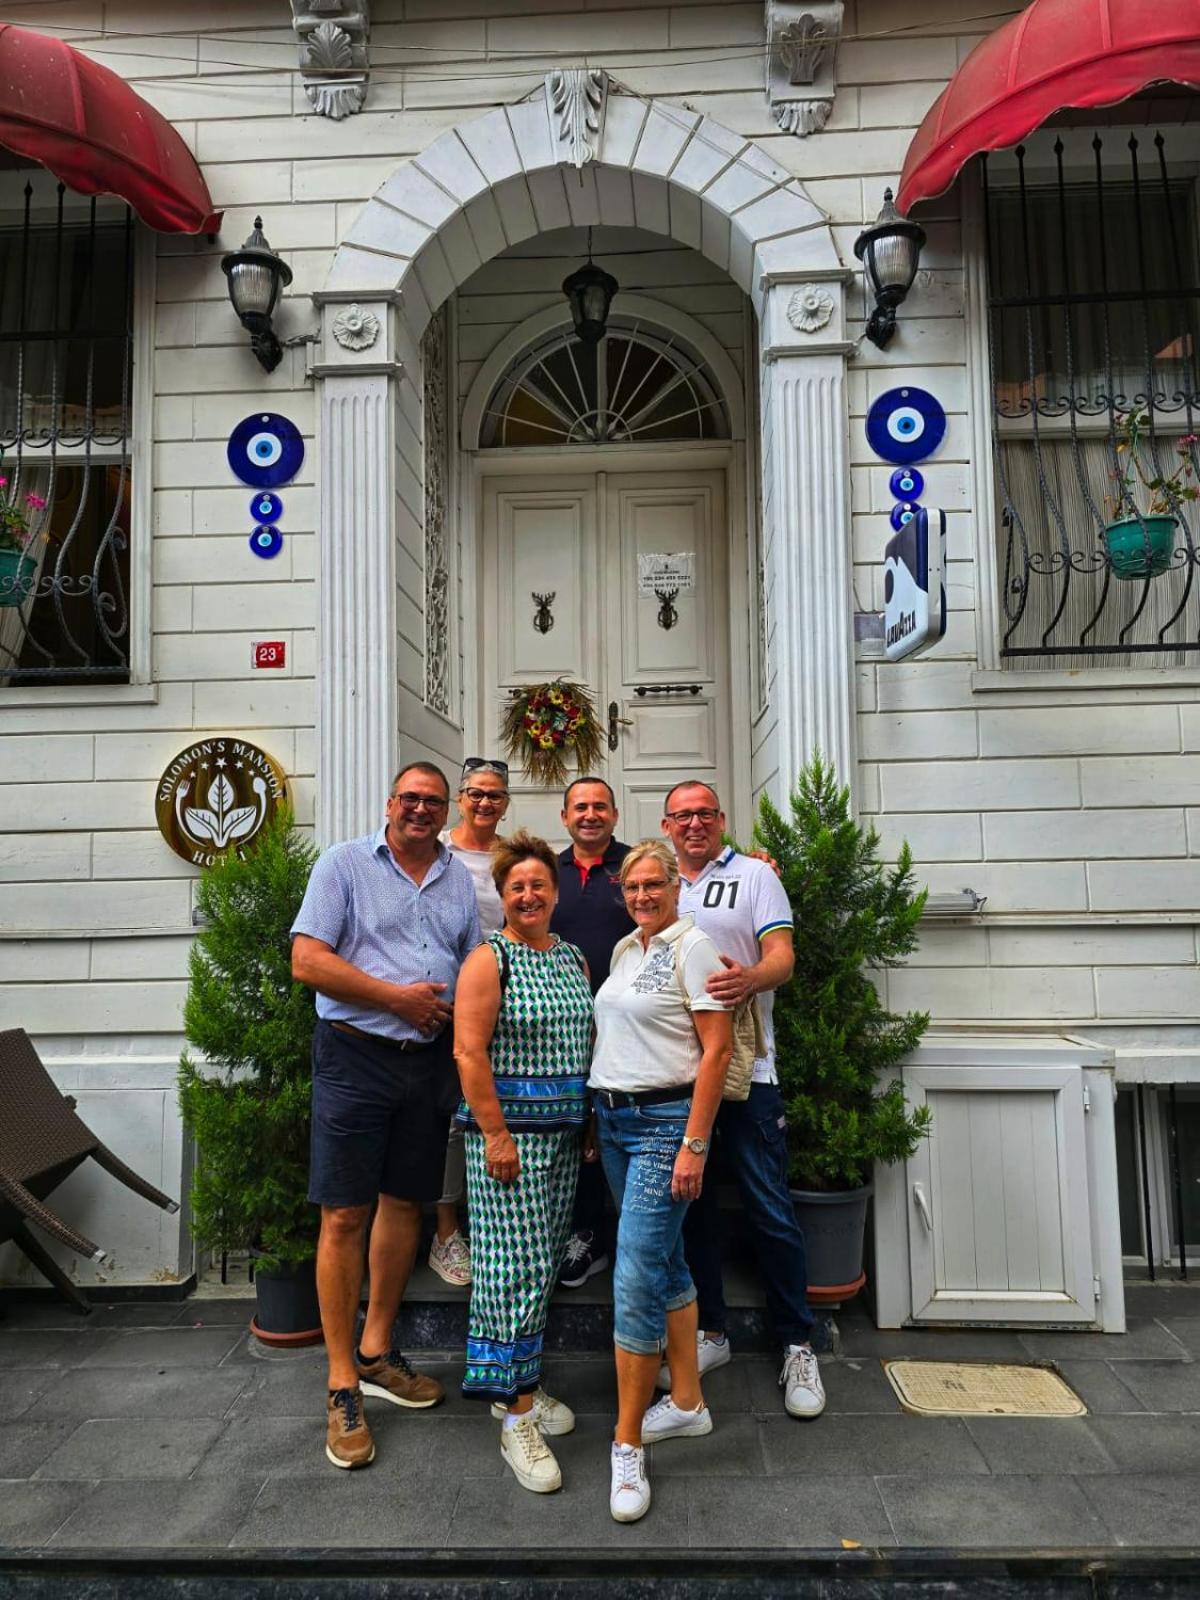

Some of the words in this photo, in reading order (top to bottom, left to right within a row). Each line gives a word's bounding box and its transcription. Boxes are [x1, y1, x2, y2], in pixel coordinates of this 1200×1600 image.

[259, 647, 277, 661] 23
[160, 741, 226, 802] SOLOMON'S
[232, 743, 284, 800] MANSION
[192, 850, 247, 866] HOTL
[703, 880, 739, 910] 01
